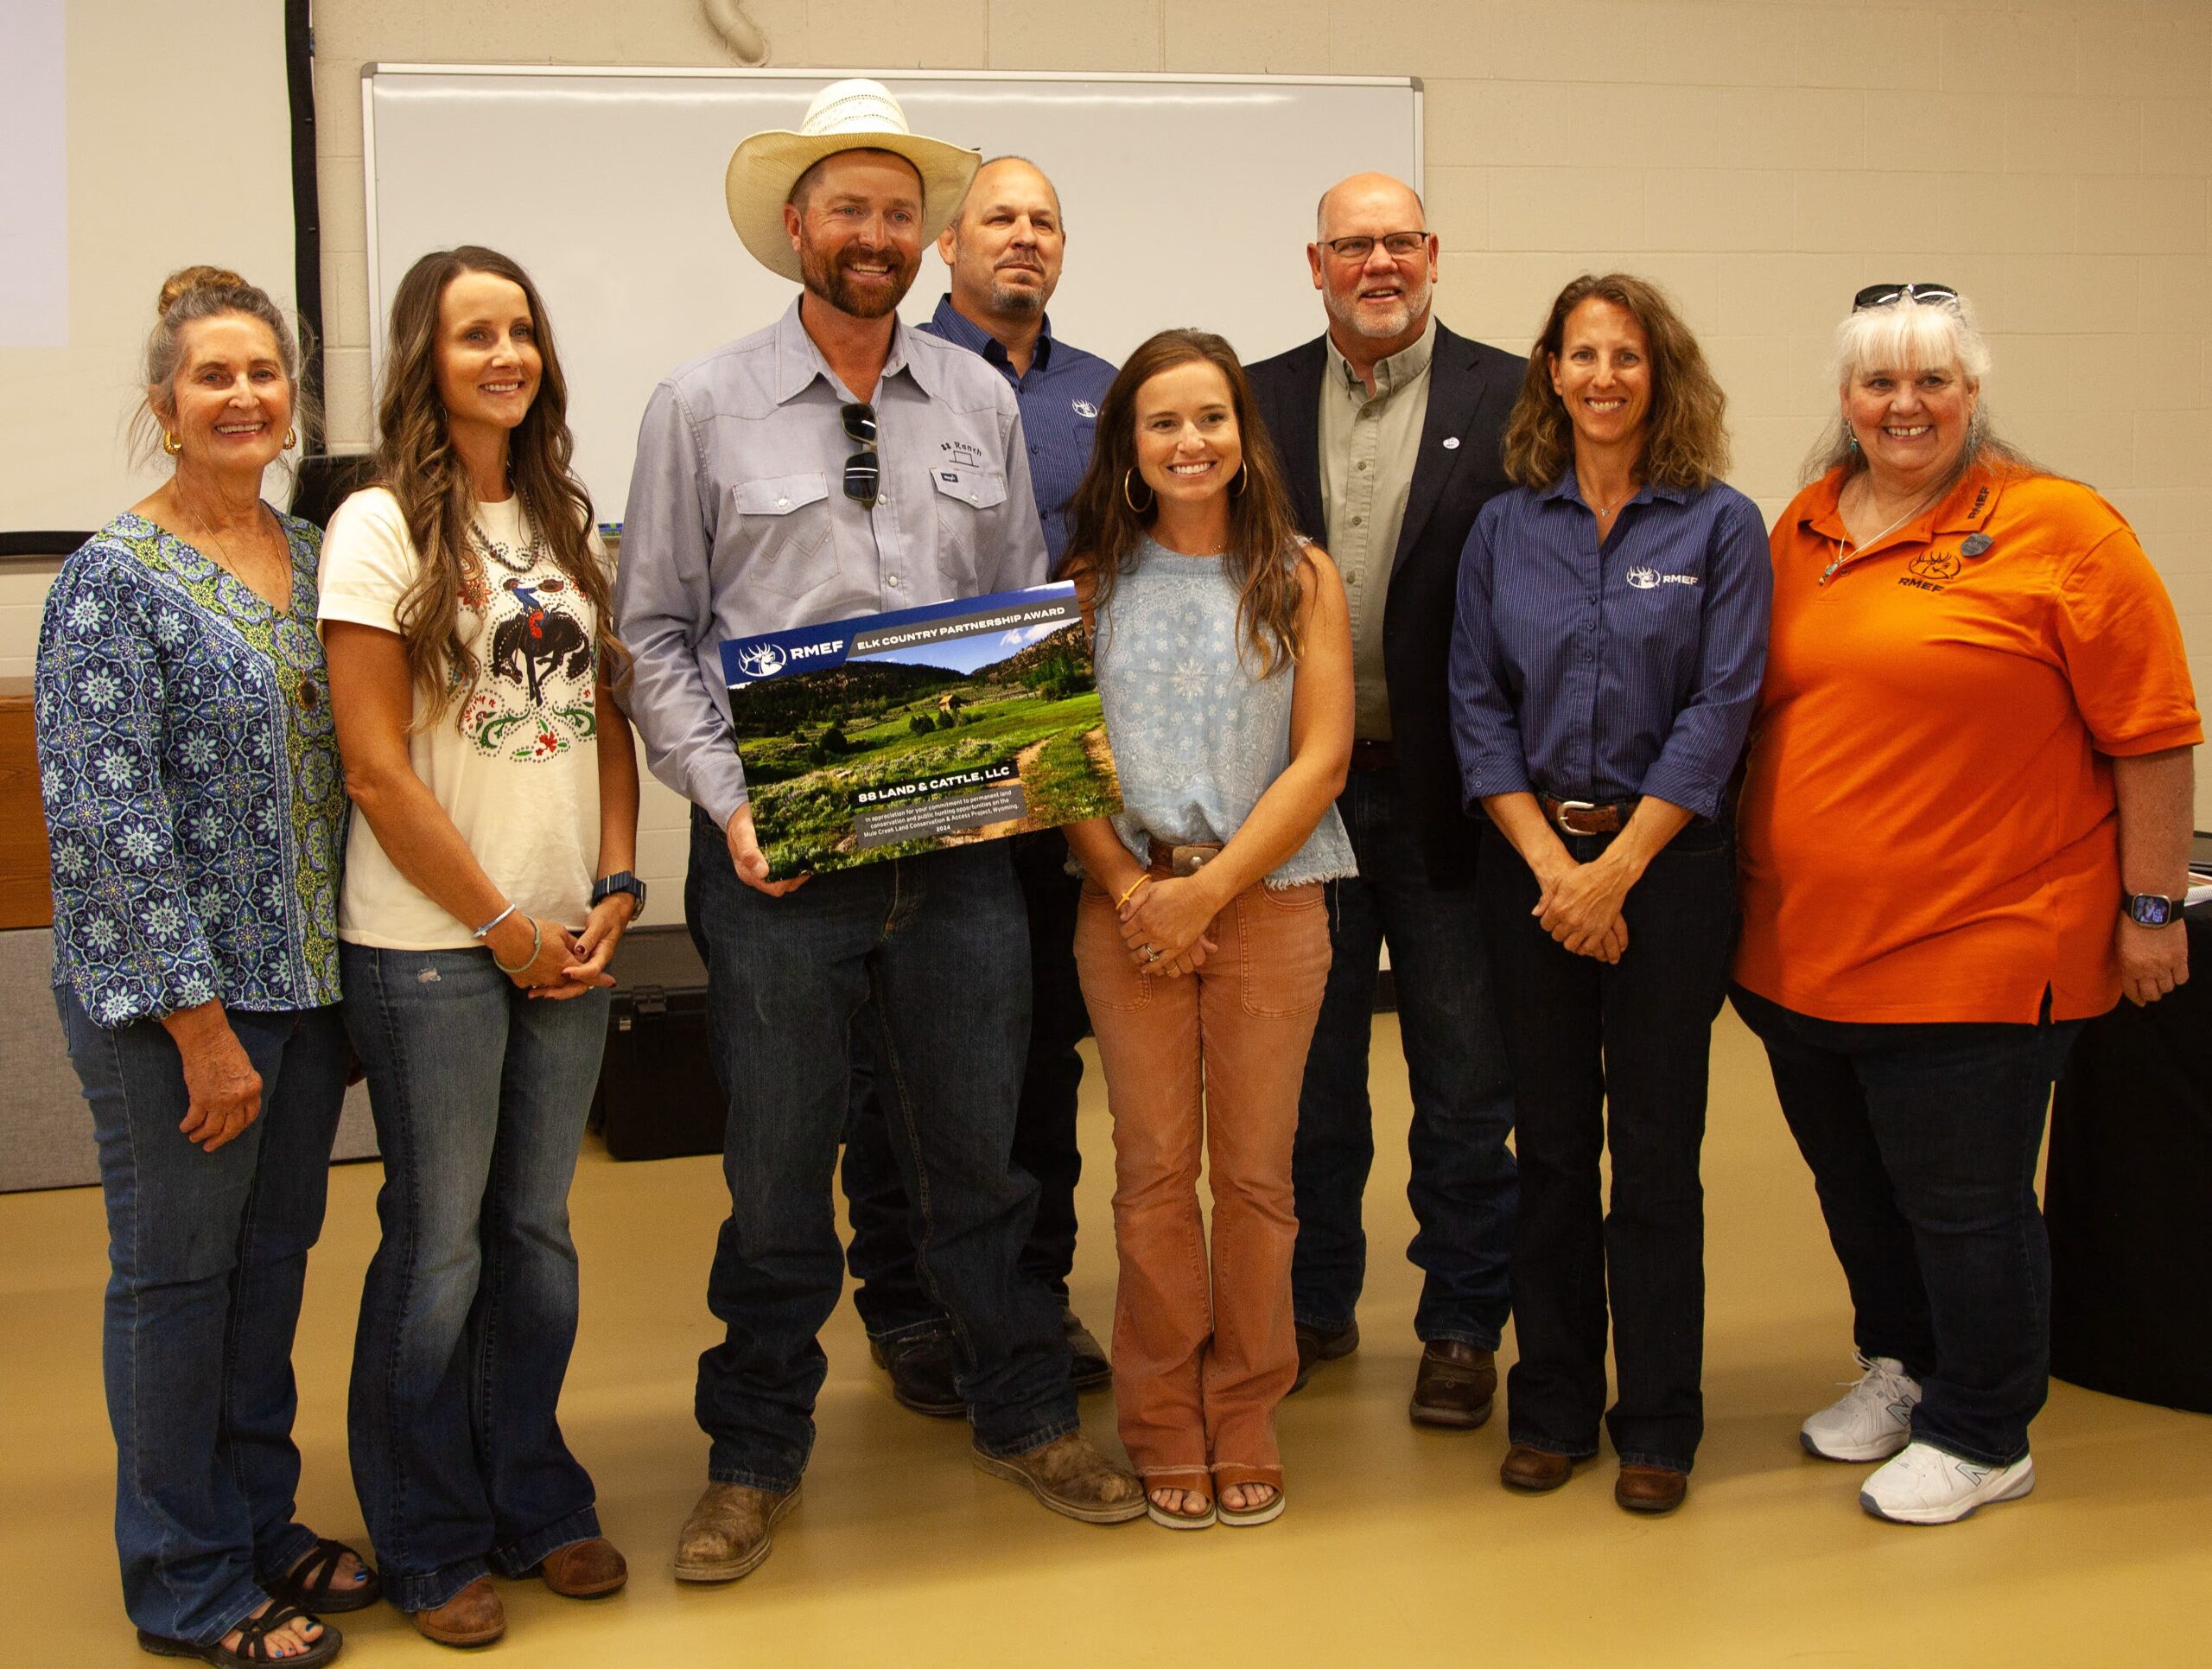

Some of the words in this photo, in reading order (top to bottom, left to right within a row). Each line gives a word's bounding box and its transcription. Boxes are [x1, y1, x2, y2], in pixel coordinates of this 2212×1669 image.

[954, 441, 982, 456] Ranch
[1967, 486, 1989, 519] RMEF
[1662, 574, 1699, 585] RMEF
[1897, 577, 1944, 592] RMEF
[857, 639, 881, 650] ELK
[881, 628, 938, 647] COUNTRY
[939, 615, 1022, 636] PARTNERSHIP
[1023, 607, 1065, 621] AWARD
[790, 640, 843, 660] RMEF
[858, 792, 877, 802] 88
[879, 785, 916, 799] LAND
[918, 782, 928, 792] &
[930, 773, 983, 789] CATTLE,
[985, 766, 1009, 779] LLC
[871, 817, 906, 830] conservation
[918, 812, 933, 822] public
[935, 807, 956, 816] hunting
[956, 801, 992, 812] opportunities
[872, 811, 906, 823] appreciation
[928, 799, 963, 811] commitment
[969, 792, 999, 804] permanent
[909, 818, 945, 829] Conservation
[952, 812, 970, 821] Access
[971, 808, 992, 817] Project,
[993, 804, 1019, 812] Wyoming.
